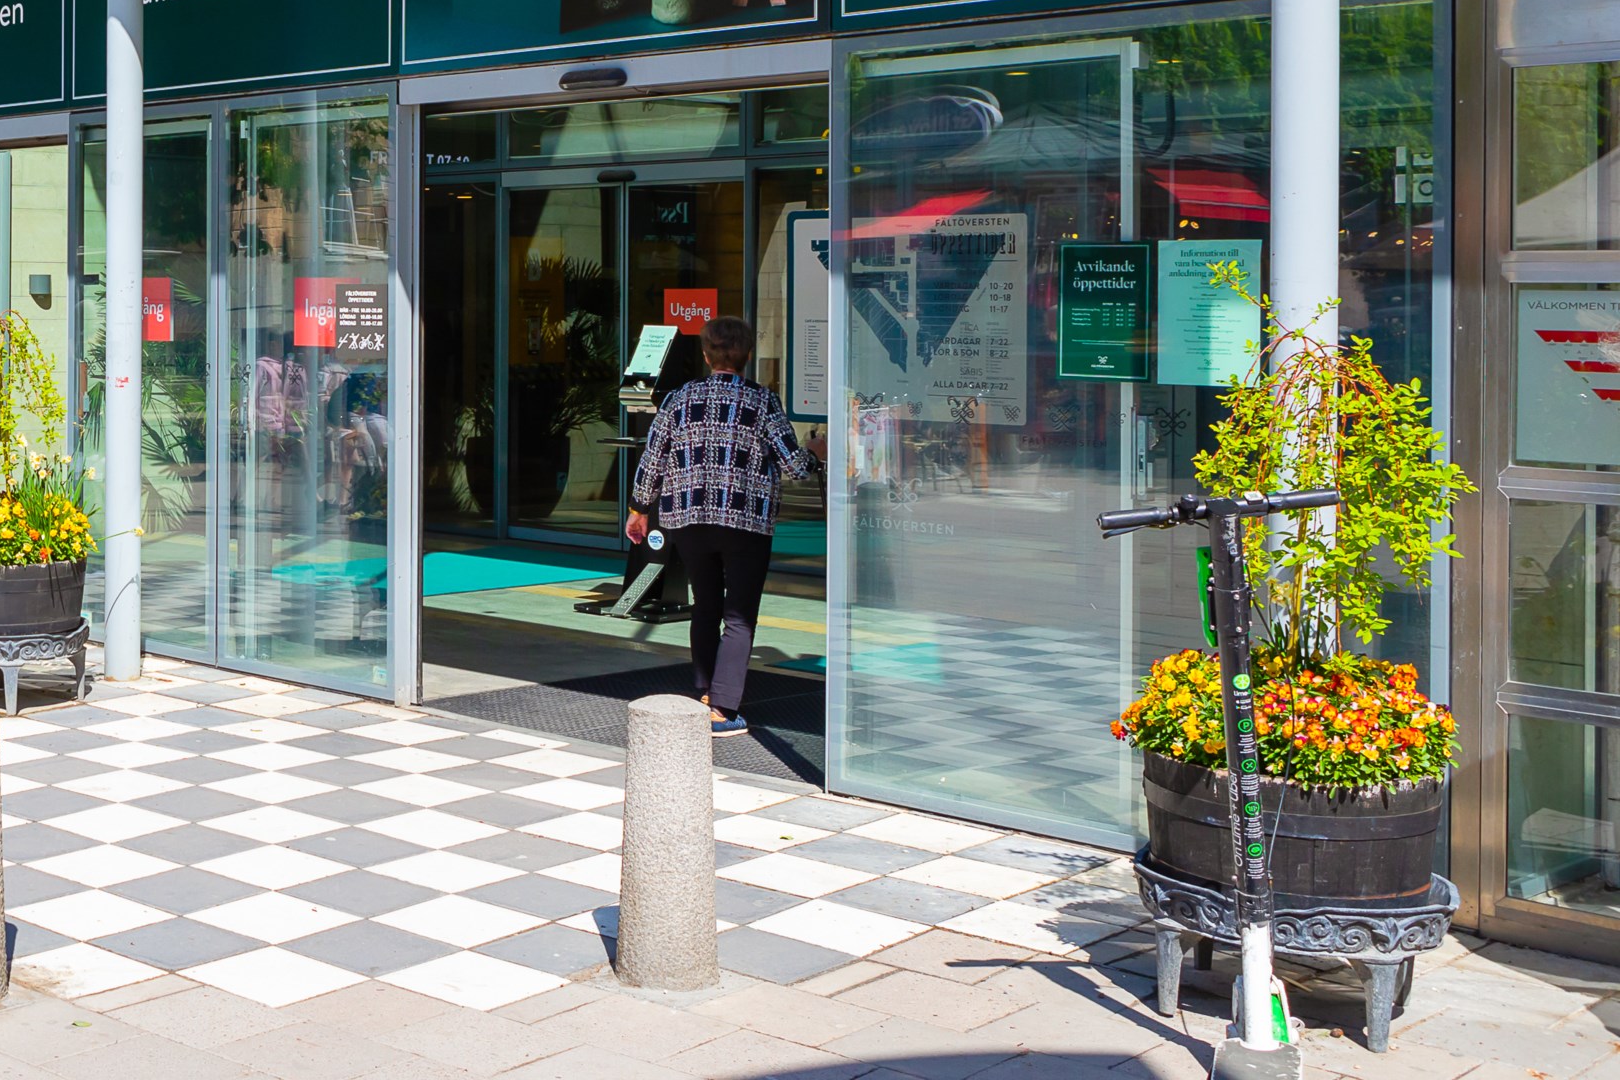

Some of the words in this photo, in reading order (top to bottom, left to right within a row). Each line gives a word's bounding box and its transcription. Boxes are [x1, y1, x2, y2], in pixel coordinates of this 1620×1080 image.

[935, 216, 1010, 227] FÄLTÖVERSTEN
[930, 229, 1016, 255] ÖPPETTIDER
[1180, 248, 1227, 257] Information
[1227, 248, 1239, 257] till
[1074, 259, 1135, 272] Avvikande
[1168, 270, 1207, 279] anledning
[1073, 277, 1136, 292] öppettider
[1527, 299, 1606, 311] VÄLKOMMEN
[670, 302, 711, 322] Utgång
[952, 349, 959, 357] &
[932, 380, 954, 389] ALLA
[956, 380, 987, 390] DAGAR
[852, 513, 955, 536] FÄLTÖVERSTEN
[1229, 770, 1239, 802] Uber
[1233, 813, 1242, 846] Lime
